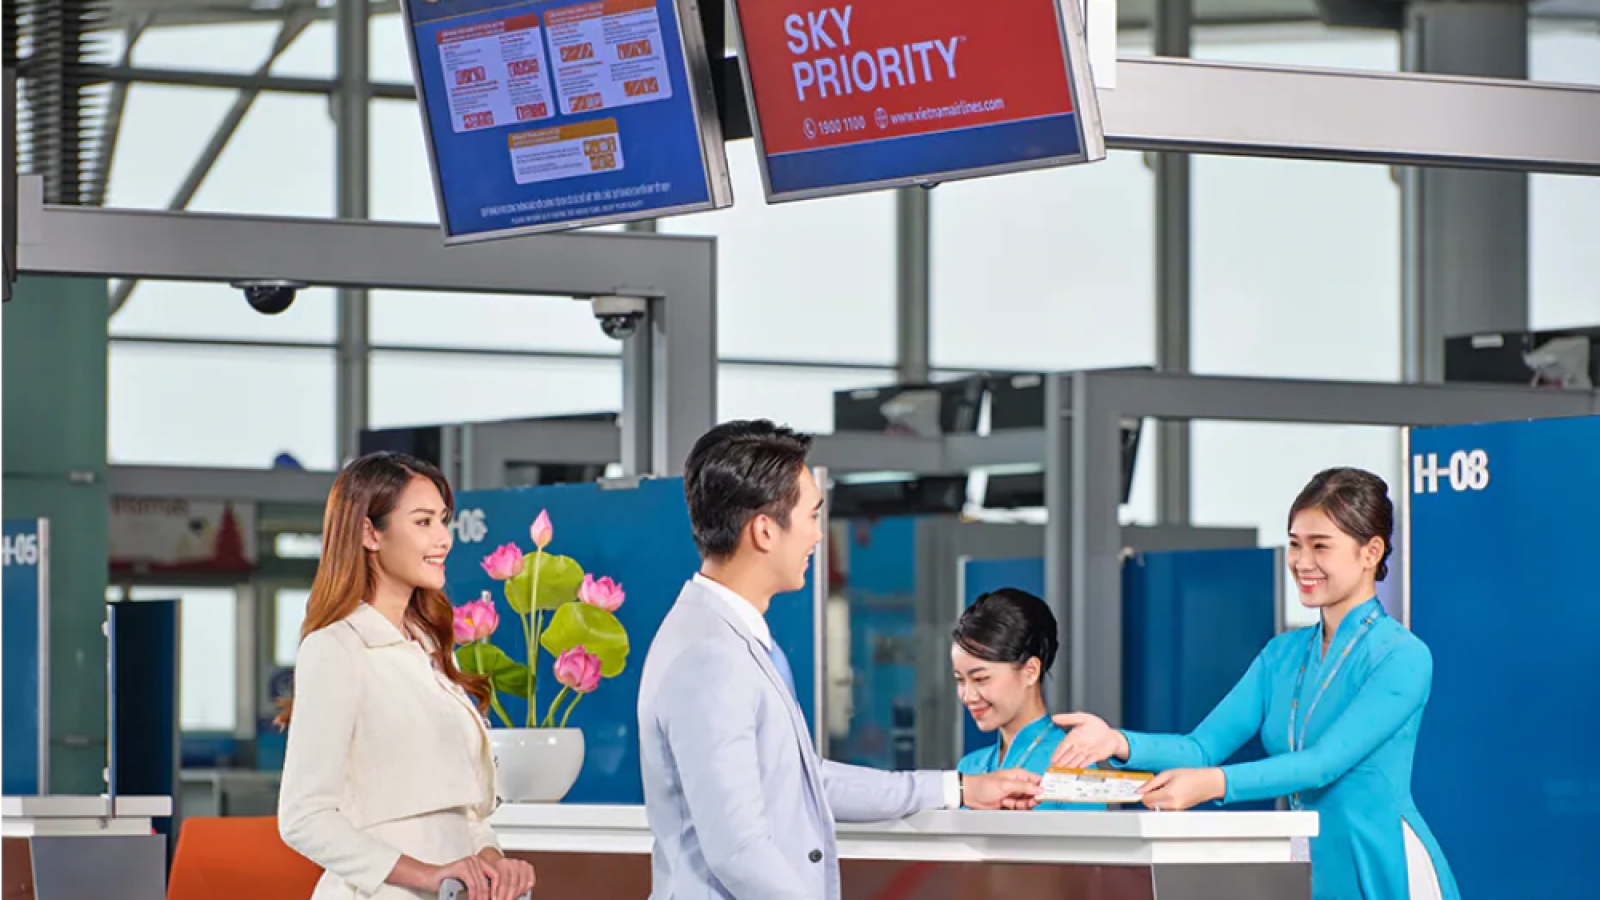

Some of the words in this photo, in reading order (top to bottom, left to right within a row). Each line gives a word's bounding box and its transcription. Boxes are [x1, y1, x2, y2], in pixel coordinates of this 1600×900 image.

[784, 5, 852, 54] SKY
[792, 36, 958, 102] PRIORITY
[817, 118, 841, 135] 1900
[844, 115, 866, 132] 1100
[890, 97, 1005, 124] www.vietnamairlines.com
[1413, 449, 1489, 494] H-08
[448, 508, 488, 543] -06
